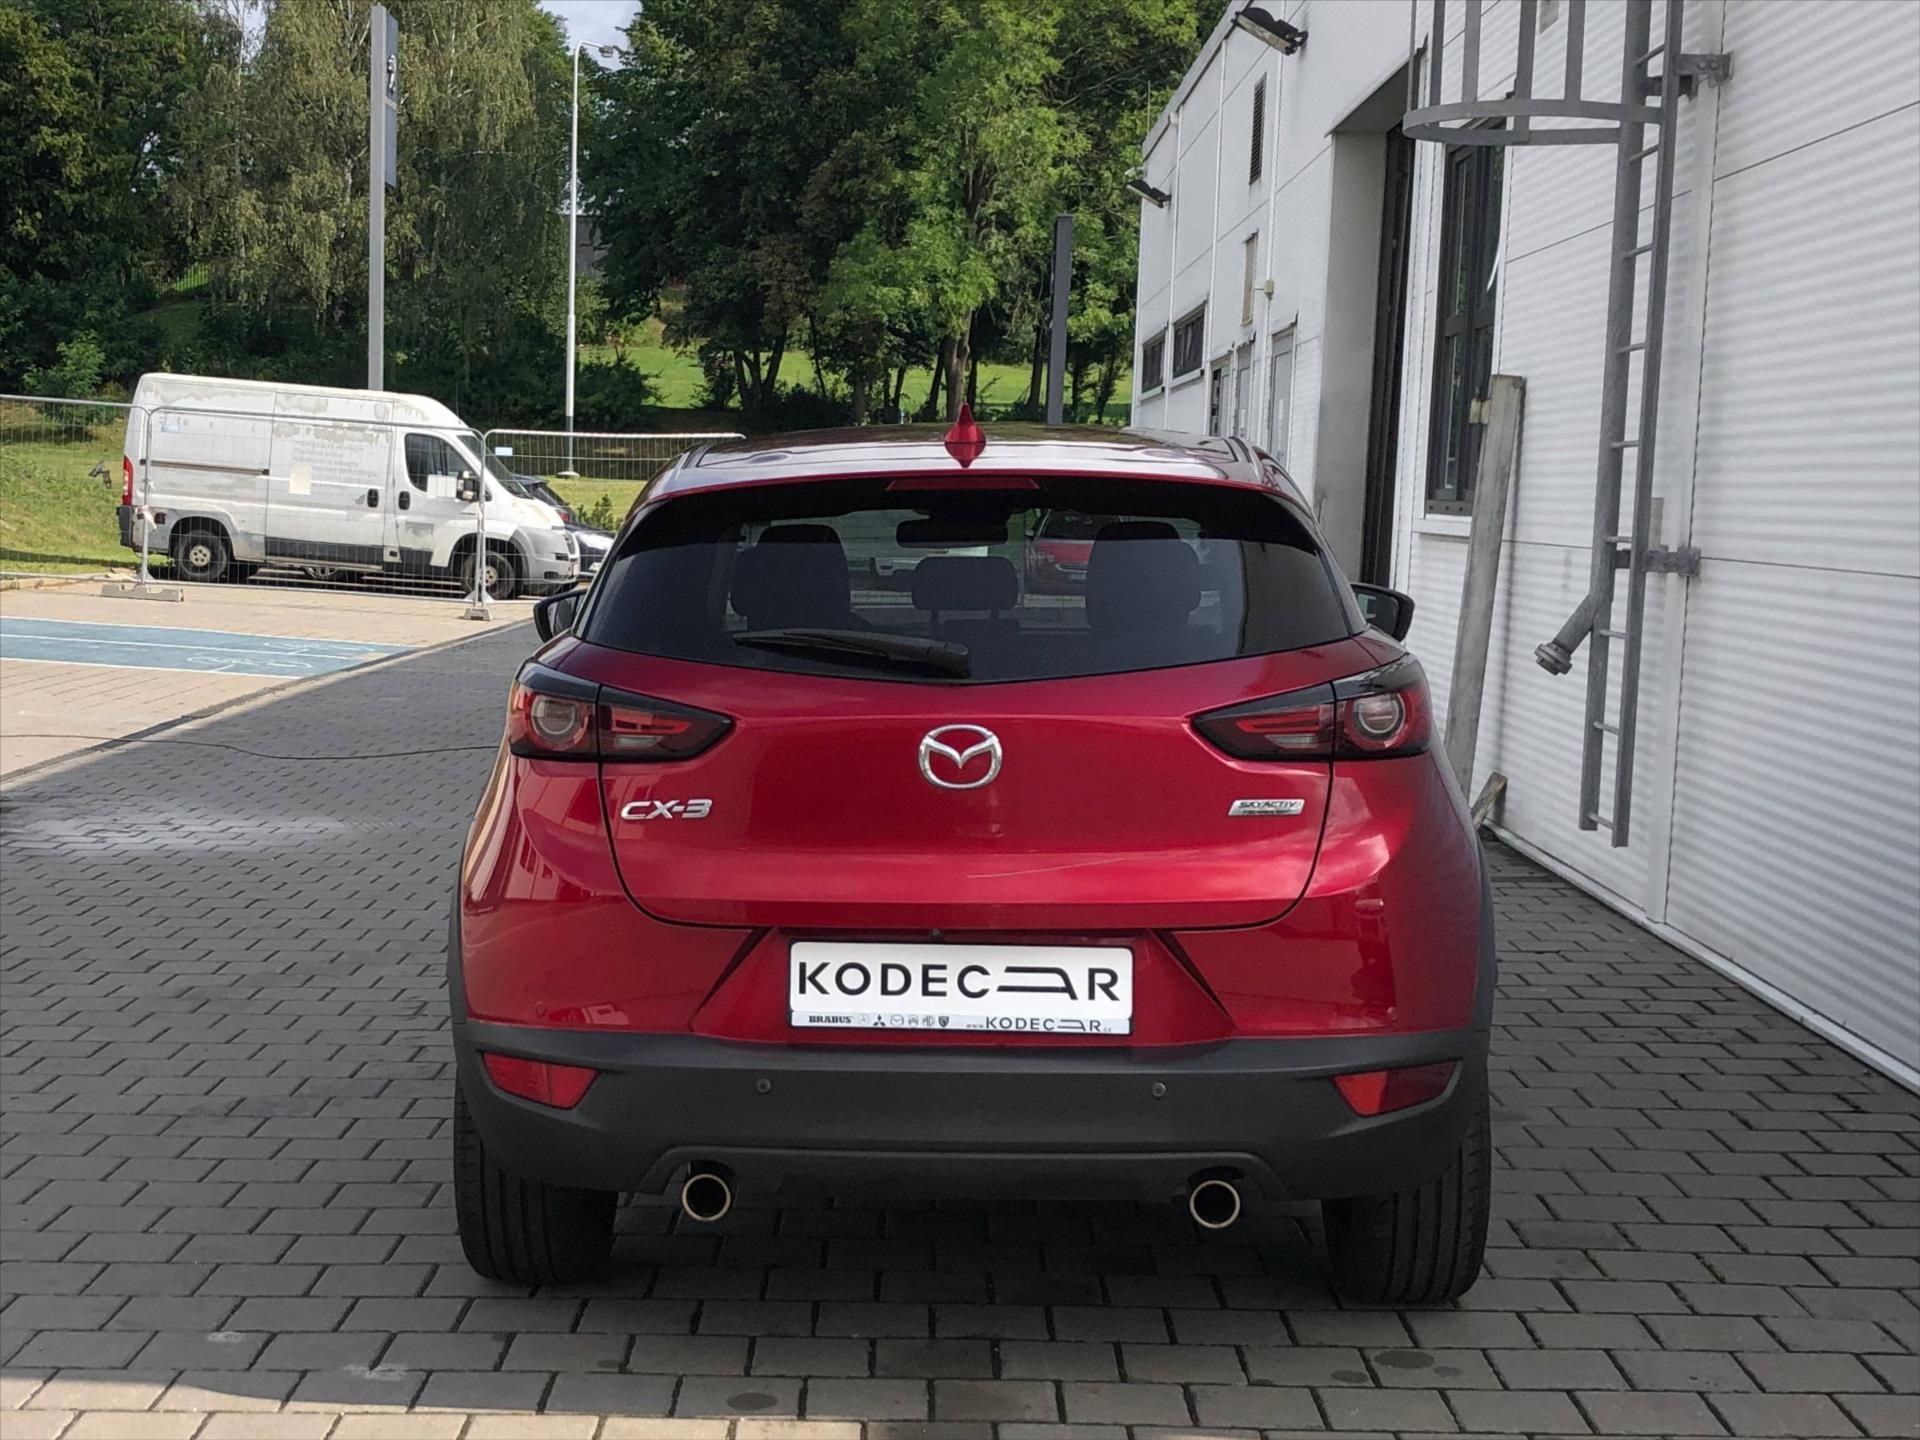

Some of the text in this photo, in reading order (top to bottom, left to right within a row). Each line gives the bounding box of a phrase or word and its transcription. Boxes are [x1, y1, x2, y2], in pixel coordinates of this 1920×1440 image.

[621, 799, 713, 820] CX-3
[1238, 800, 1298, 809] SKYACTIV
[798, 961, 1121, 1002] KODECAR
[808, 1014, 852, 1024] BRABUS
